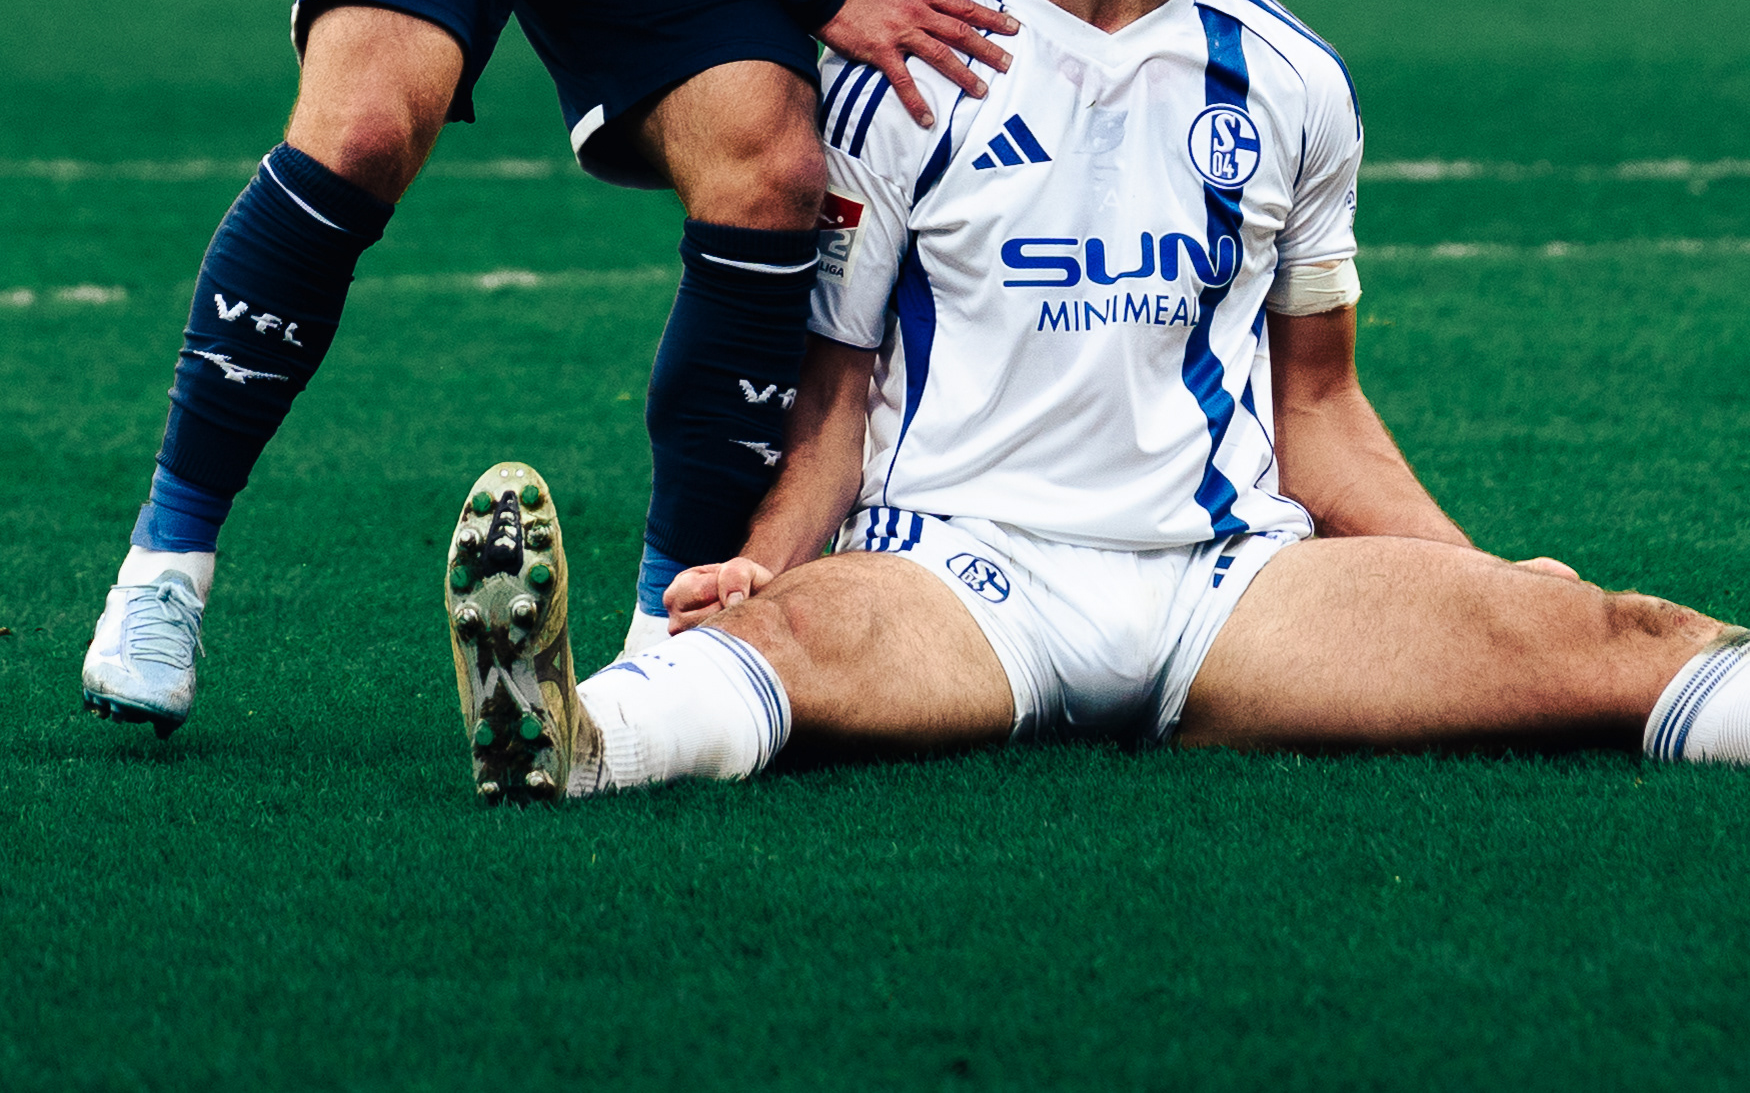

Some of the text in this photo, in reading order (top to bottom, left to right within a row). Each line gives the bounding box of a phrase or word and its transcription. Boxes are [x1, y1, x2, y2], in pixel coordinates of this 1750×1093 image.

[1212, 151, 1235, 179] 04
[827, 229, 851, 258] 2
[1000, 231, 1237, 289] SUN
